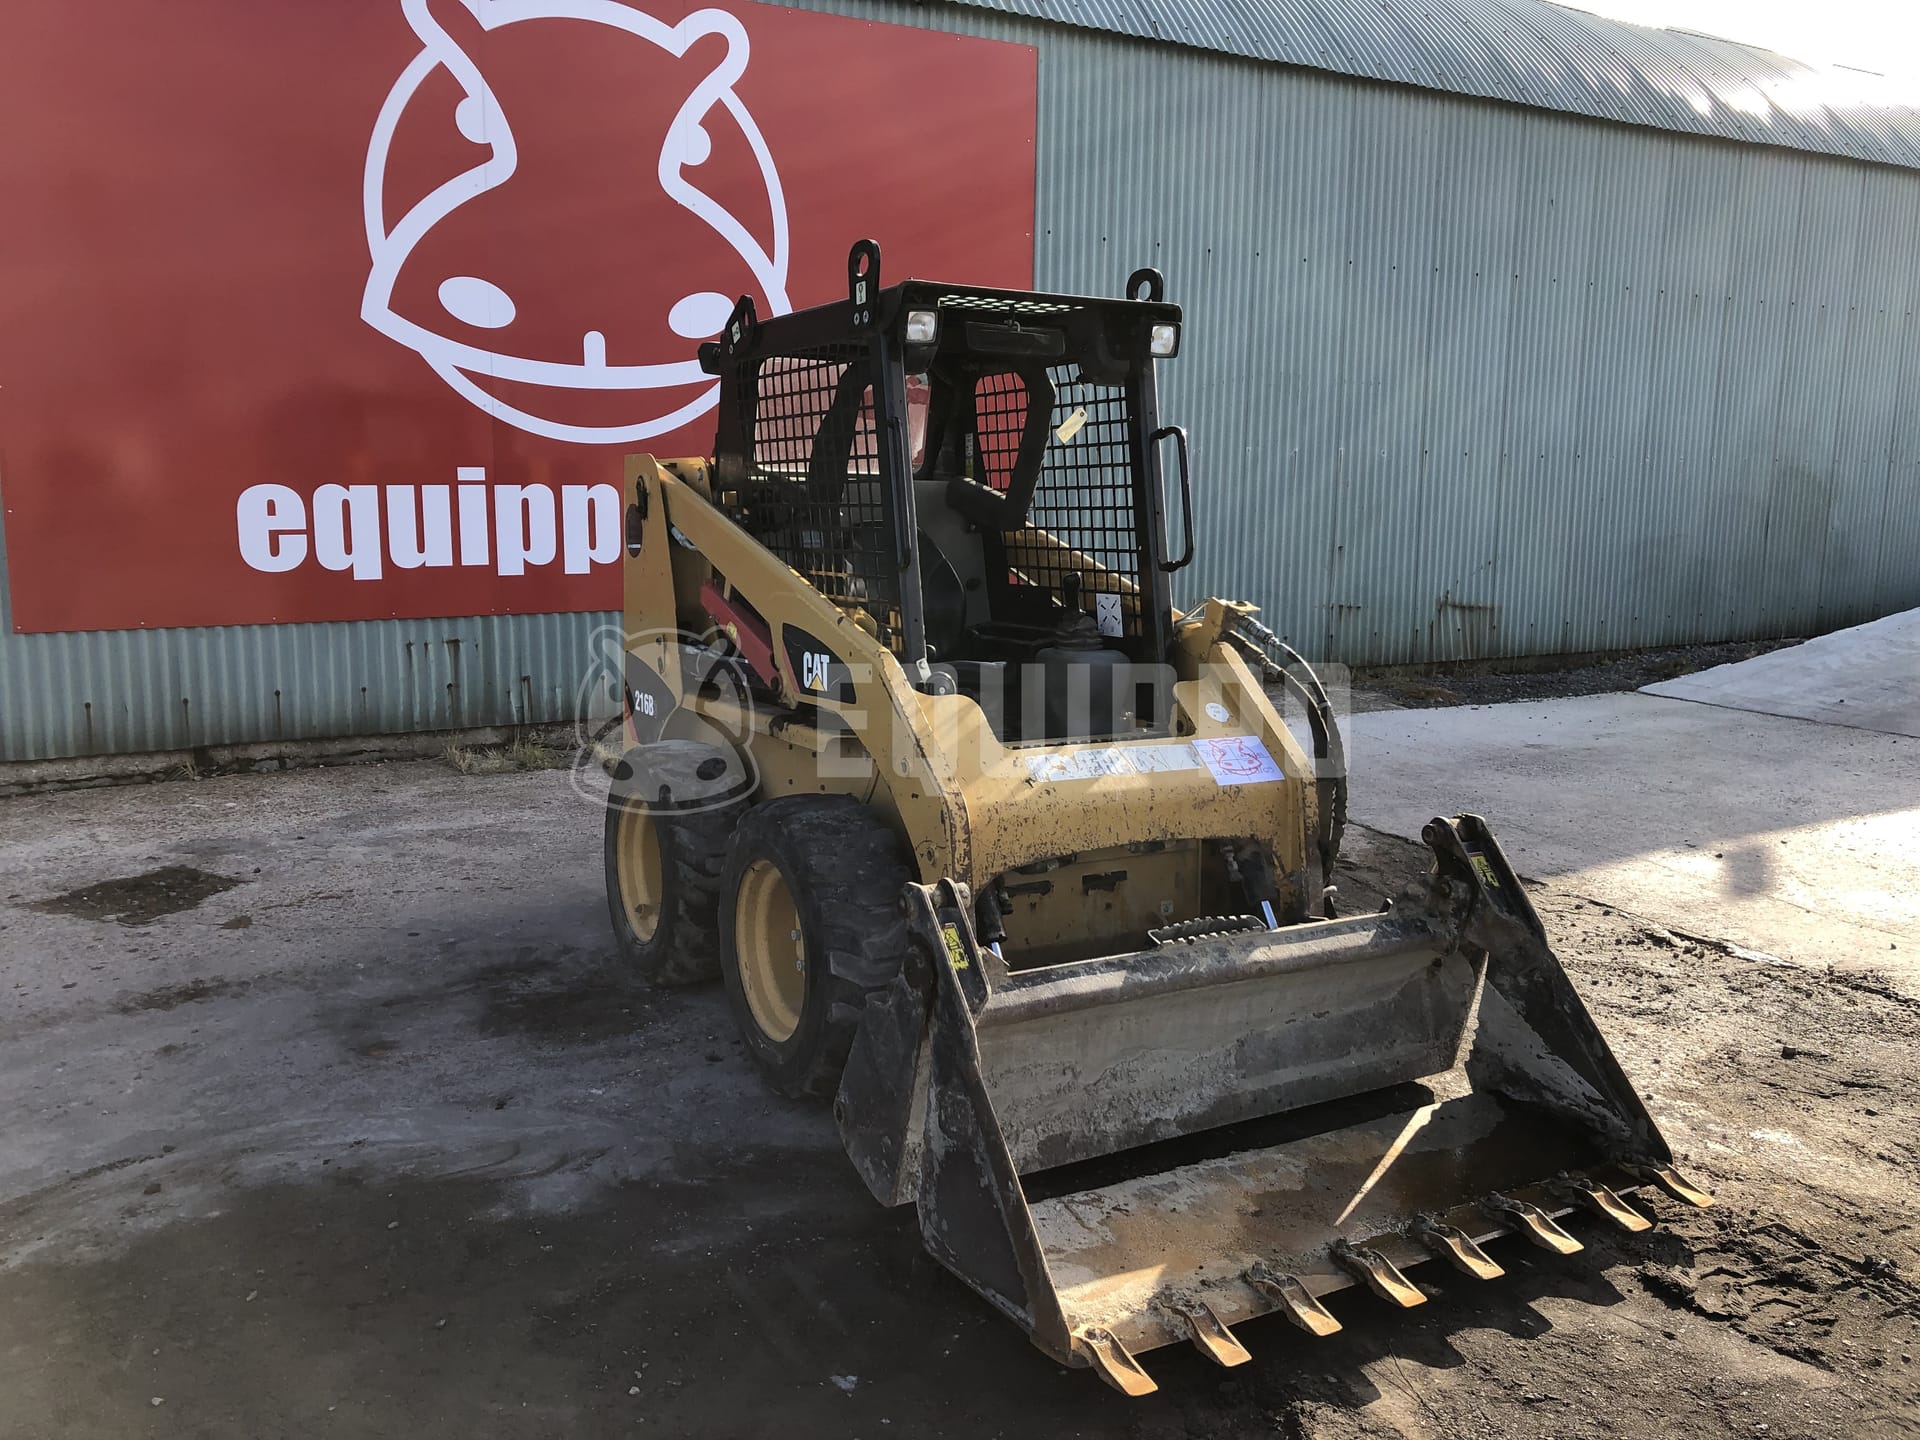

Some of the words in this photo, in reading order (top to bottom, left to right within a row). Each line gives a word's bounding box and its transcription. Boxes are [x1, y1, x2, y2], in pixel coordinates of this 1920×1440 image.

[236, 466, 621, 580] equipp
[803, 651, 830, 692] CAT
[634, 689, 654, 717] 216B
